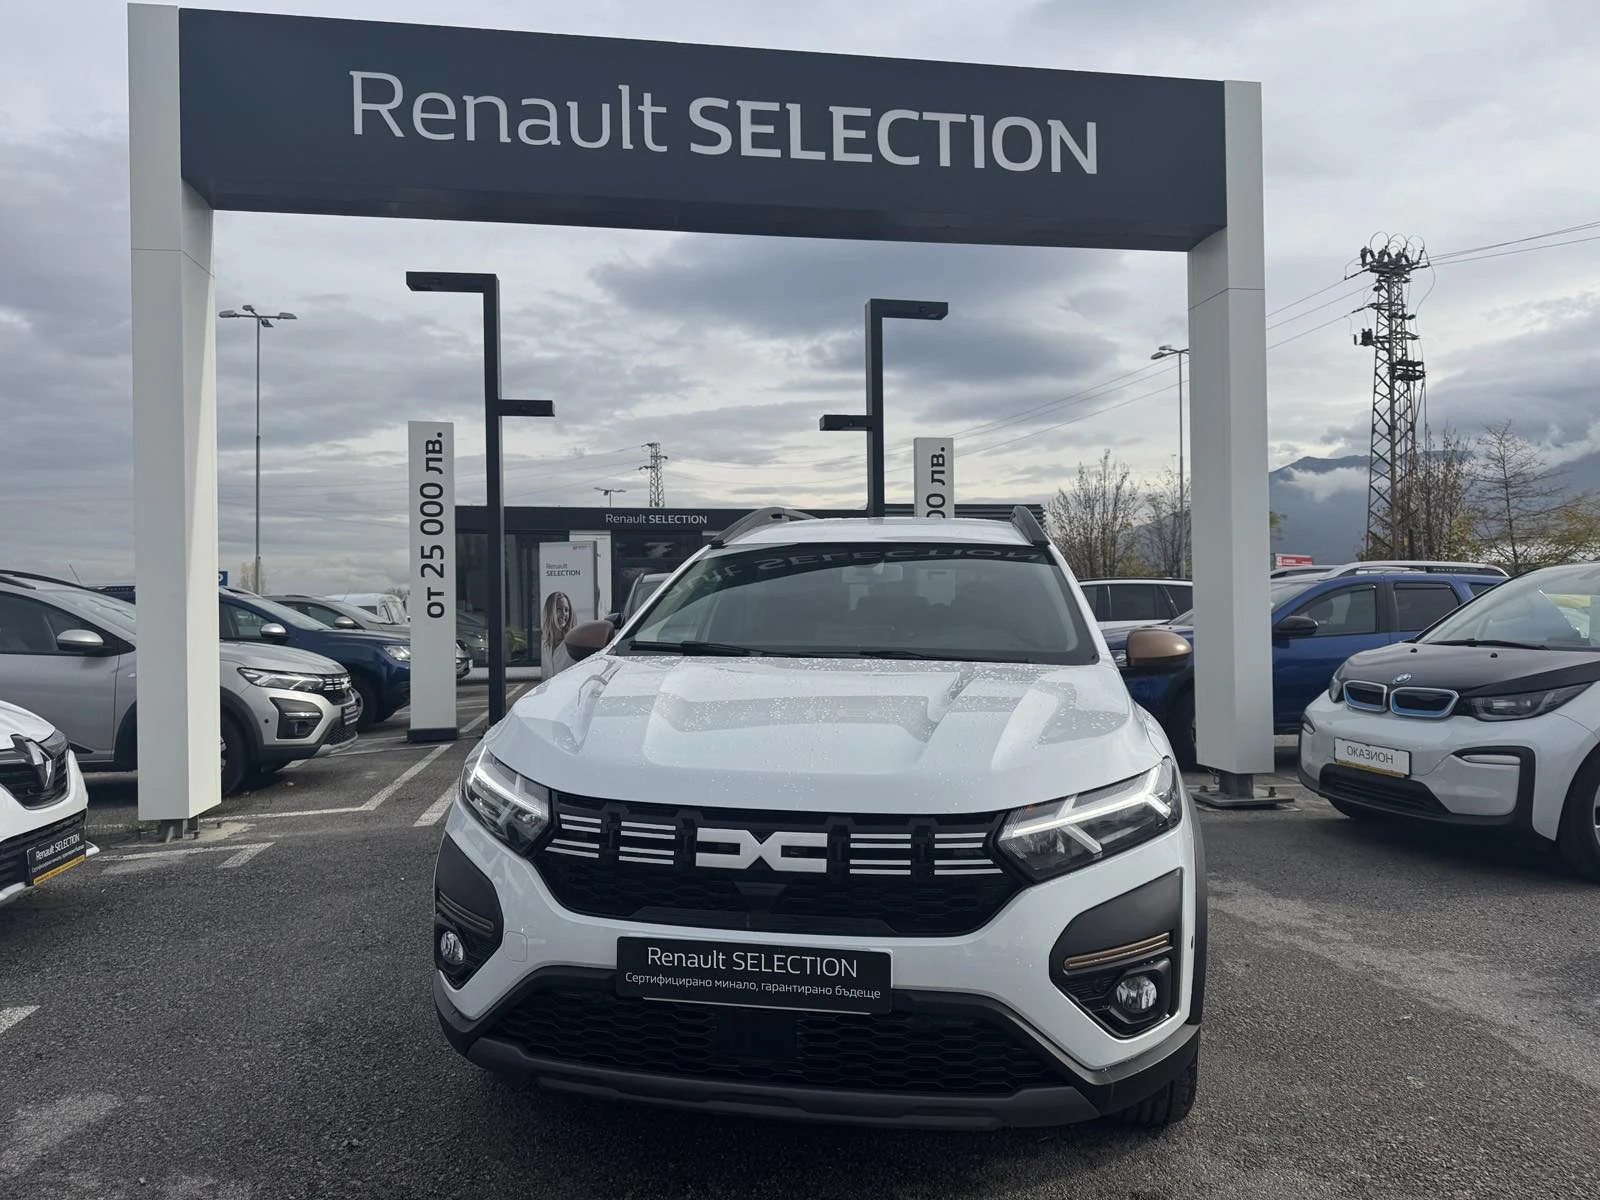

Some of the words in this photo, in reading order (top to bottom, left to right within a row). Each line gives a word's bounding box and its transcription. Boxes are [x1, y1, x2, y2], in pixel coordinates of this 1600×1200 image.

[349, 70, 668, 152] Renault
[688, 97, 1098, 175] SELECTION
[425, 432, 443, 475] лв.
[931, 446, 946, 486] лв.
[419, 482, 445, 536] 000
[605, 513, 647, 524] Renault
[648, 514, 708, 525] SELECTION
[420, 544, 445, 579] 25
[545, 569, 581, 577] SELECTION
[427, 587, 445, 618] от
[1346, 745, 1394, 764] ОКАЗИОН
[35, 844, 55, 861] Renault
[54, 833, 80, 853] SELECTION
[647, 946, 727, 970] Renault
[732, 952, 858, 978] SELECTION
[625, 972, 712, 988] Сертифицирано
[714, 979, 759, 993] минало,
[761, 982, 832, 997] гарантирано
[835, 985, 881, 999] бъдеще
